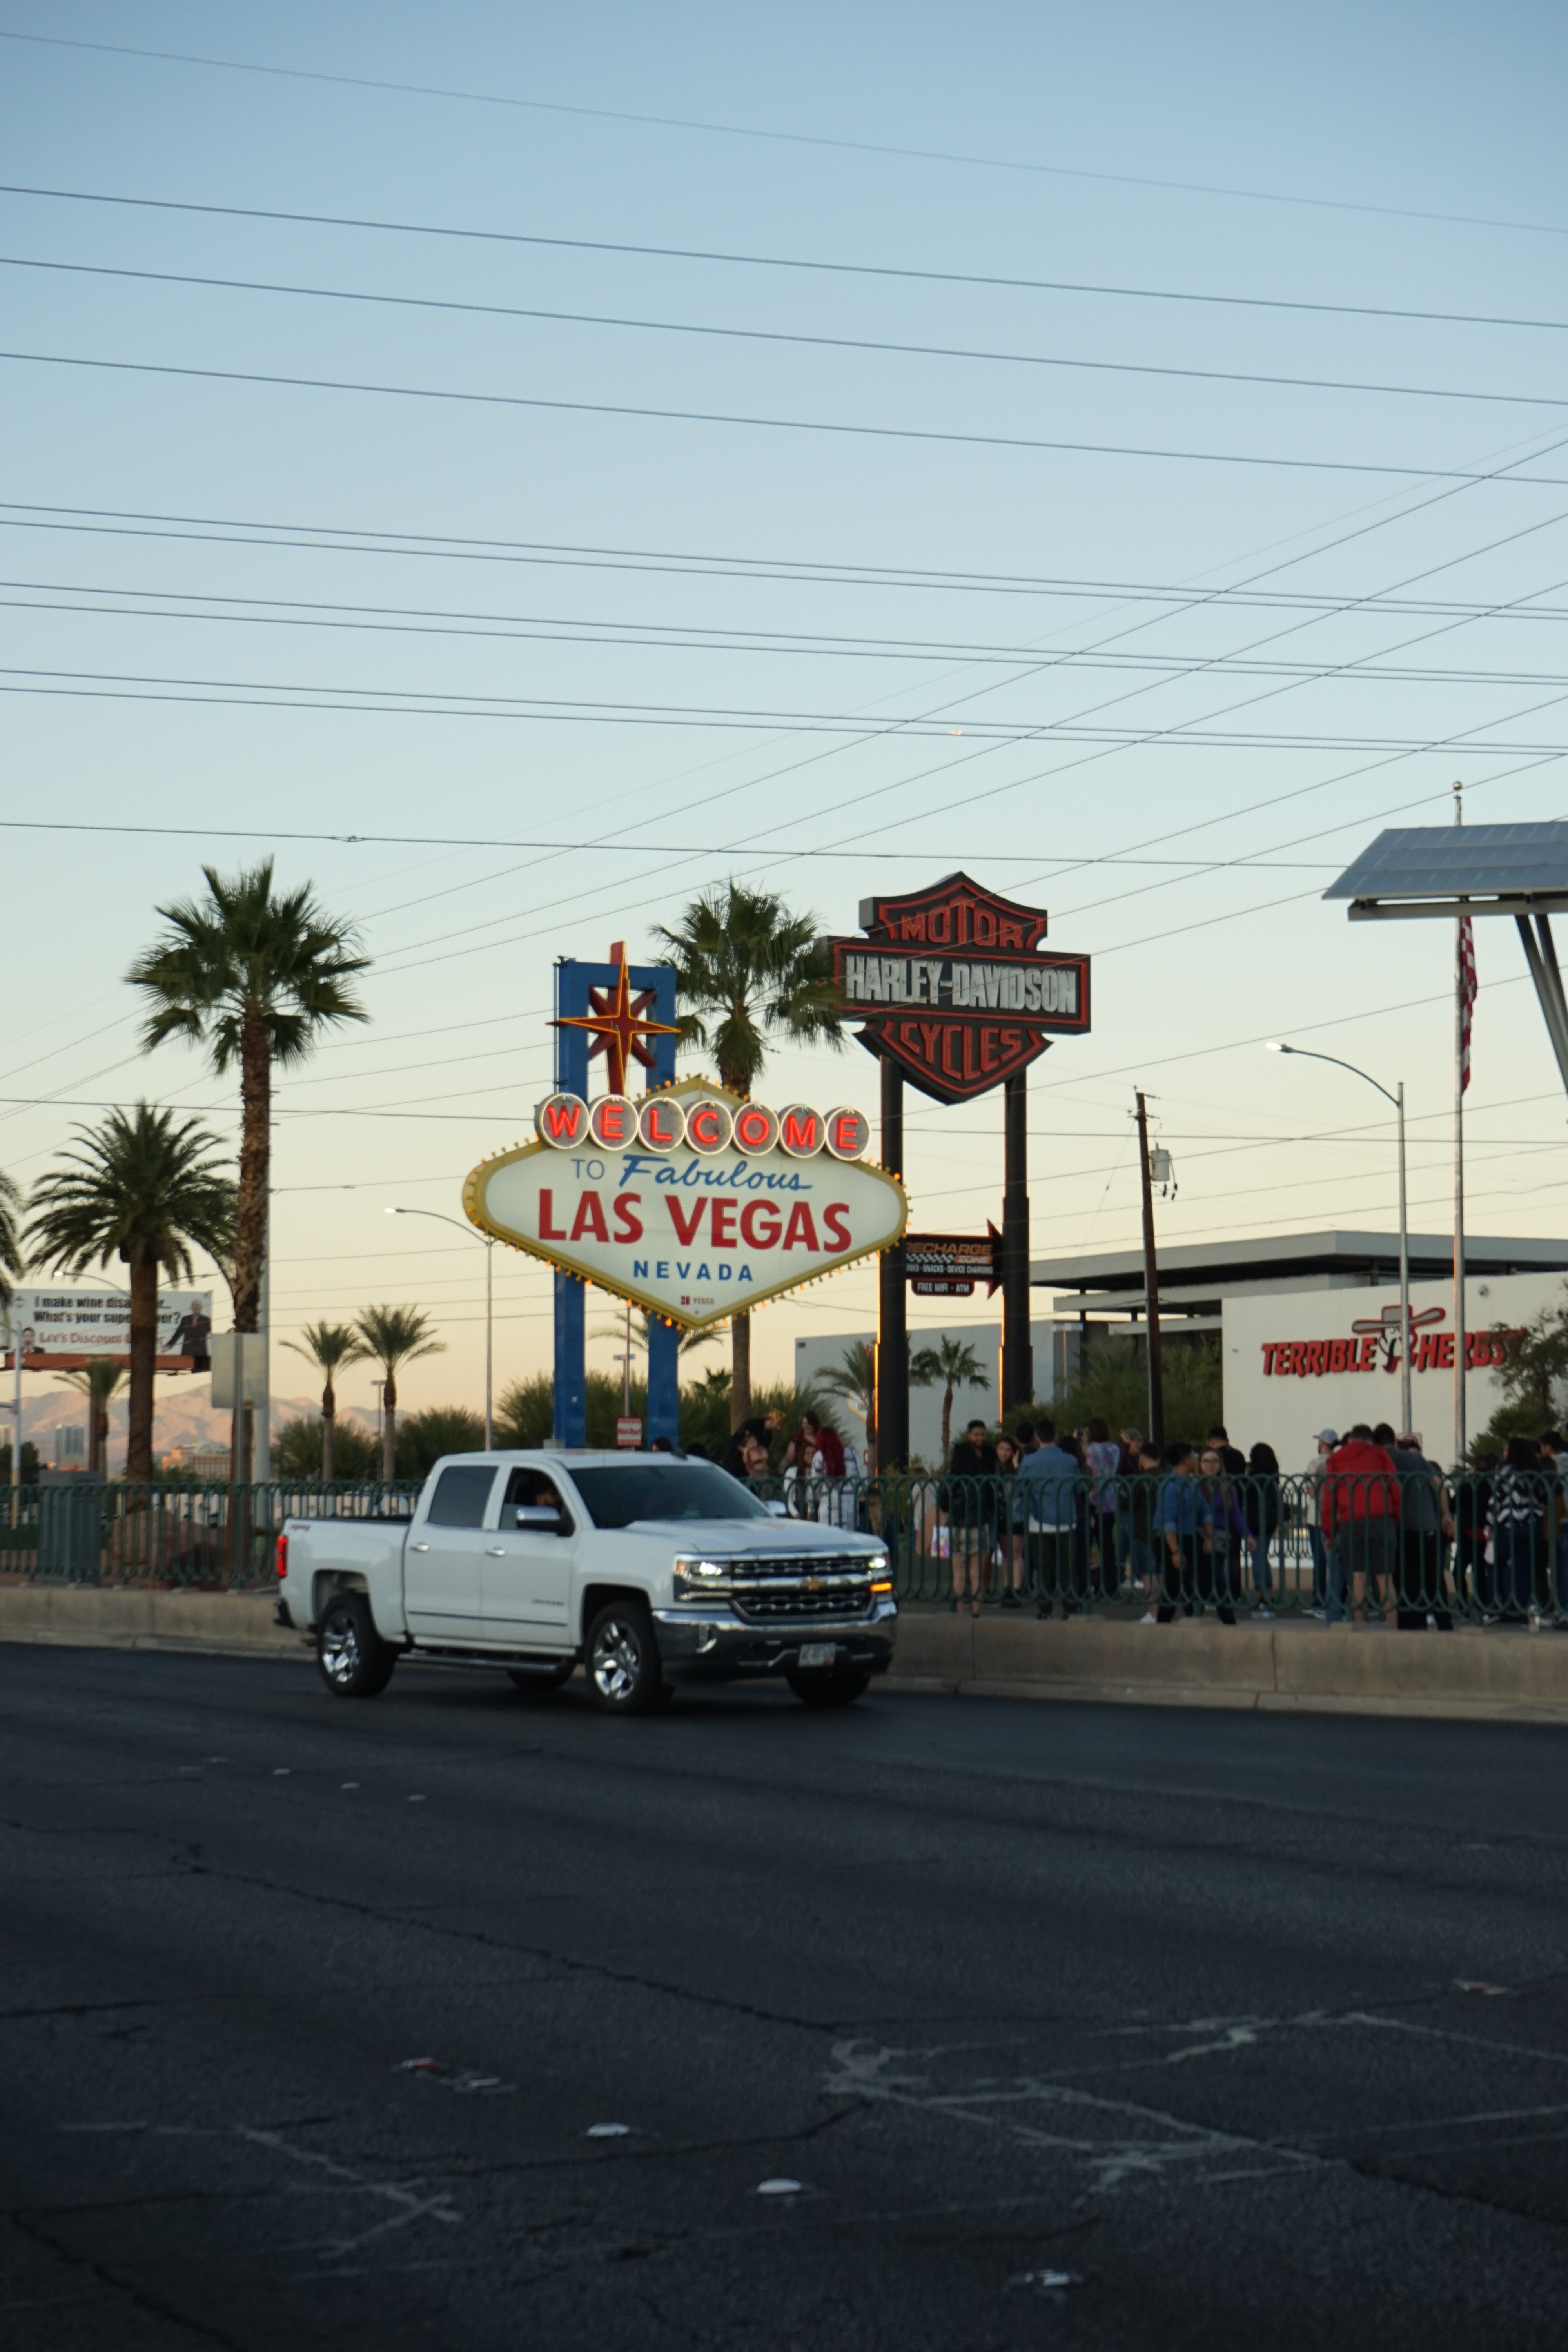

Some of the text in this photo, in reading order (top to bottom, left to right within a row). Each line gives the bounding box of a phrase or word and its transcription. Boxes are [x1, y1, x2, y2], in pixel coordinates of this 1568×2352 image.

[900, 895, 1025, 950] MOTOR
[845, 954, 1076, 1014] HARLEY-DAVIDSON
[899, 1021, 1022, 1081] CYCLES
[546, 1105, 858, 1150] WELCOME
[571, 1154, 813, 1191] TO Fabulous
[538, 1188, 852, 1253] LAS VEGAS
[633, 1260, 754, 1282] NEVADA
[917, 1282, 970, 1293] FREE WIFI ATM
[923, 1264, 944, 1273] SNACKS
[947, 1265, 966, 1274] DEVICE
[967, 1265, 994, 1274] CHARGING
[34, 1311, 73, 1323] What's
[76, 1314, 100, 1324] your
[35, 1295, 171, 1309] I make wine disar...
[71, 1333, 122, 1344] Discount
[1261, 1328, 1525, 1377] TERRIBLE HERBS
